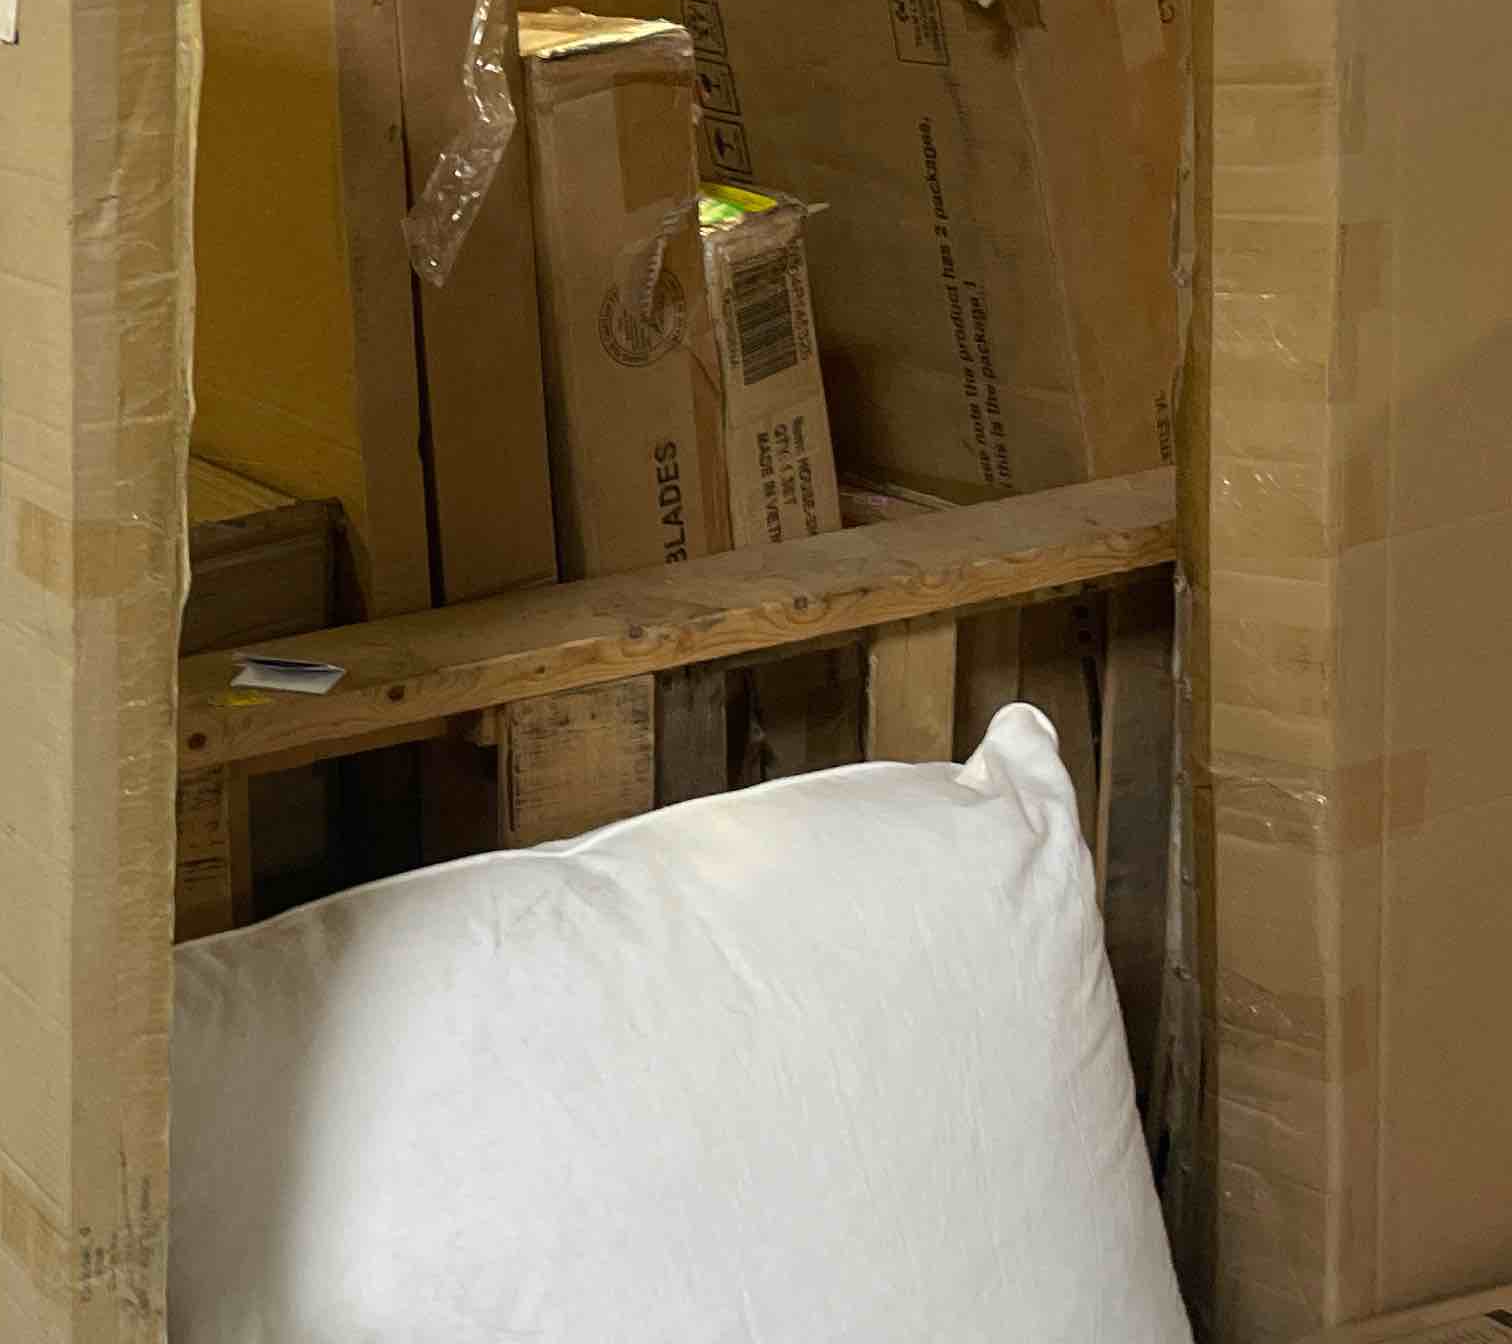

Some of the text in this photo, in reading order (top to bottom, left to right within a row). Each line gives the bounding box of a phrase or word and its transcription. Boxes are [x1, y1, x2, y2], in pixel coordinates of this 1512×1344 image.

[940, 245, 957, 279] has
[946, 285, 974, 363] product
[965, 367, 978, 397] the
[987, 383, 1001, 415] the
[654, 441, 688, 564] BLADES
